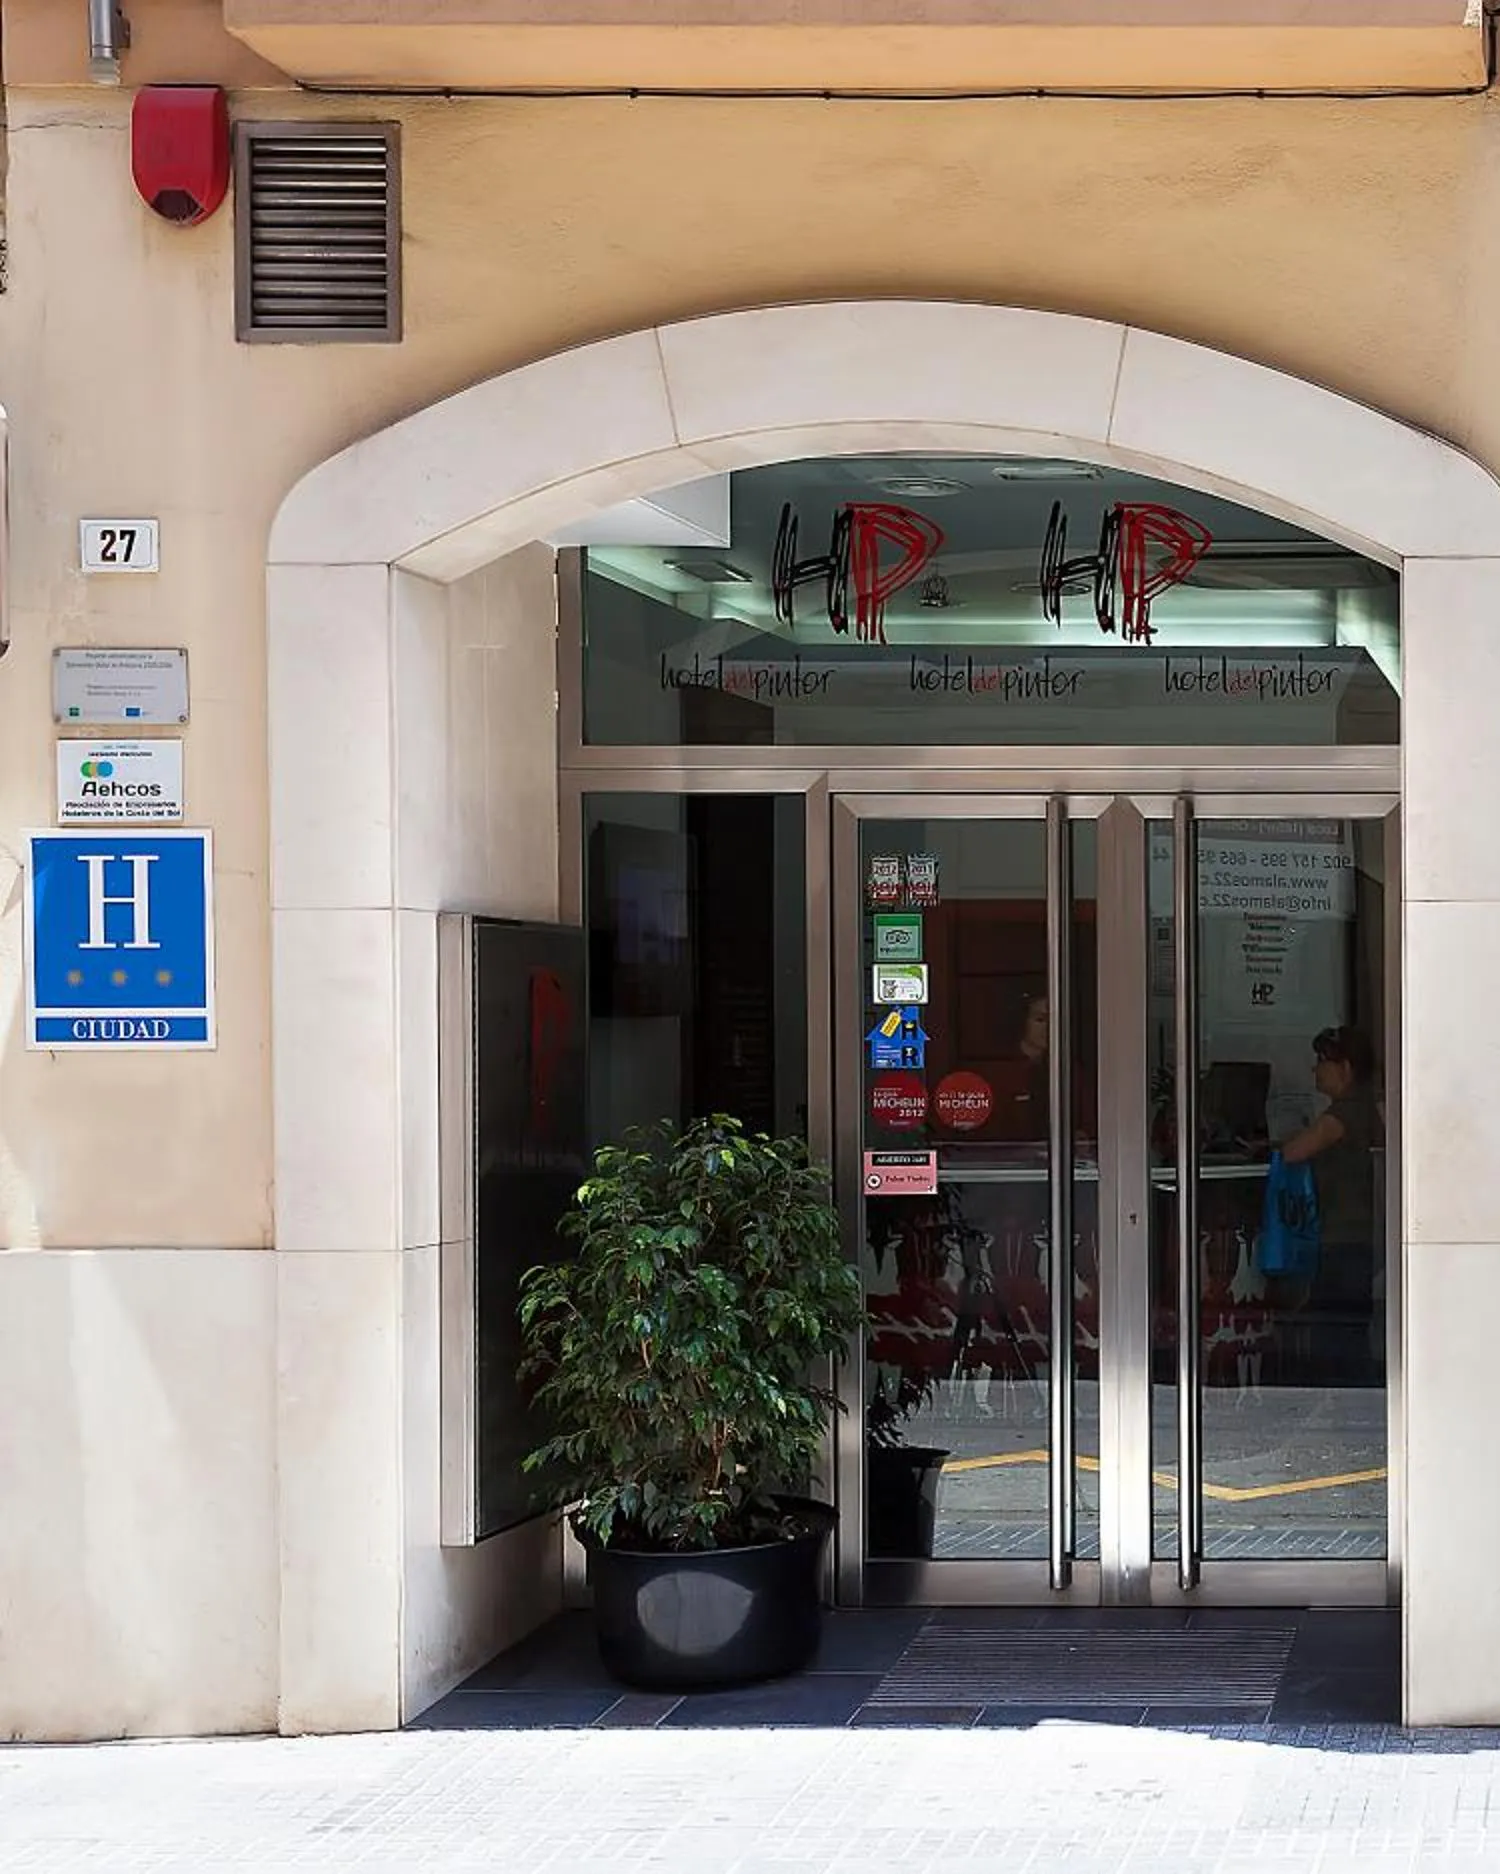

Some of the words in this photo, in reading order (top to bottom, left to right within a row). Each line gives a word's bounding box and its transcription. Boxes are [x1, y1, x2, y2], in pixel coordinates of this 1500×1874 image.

[99, 529, 137, 563] 27
[773, 502, 945, 645] HP
[1040, 501, 1212, 646] HP
[81, 781, 162, 797] Aehcos
[77, 854, 161, 949] H
[72, 1019, 171, 1040] CIUDAD
[873, 1097, 926, 1109] MICHELIN
[939, 1098, 989, 1109] MICHELIN
